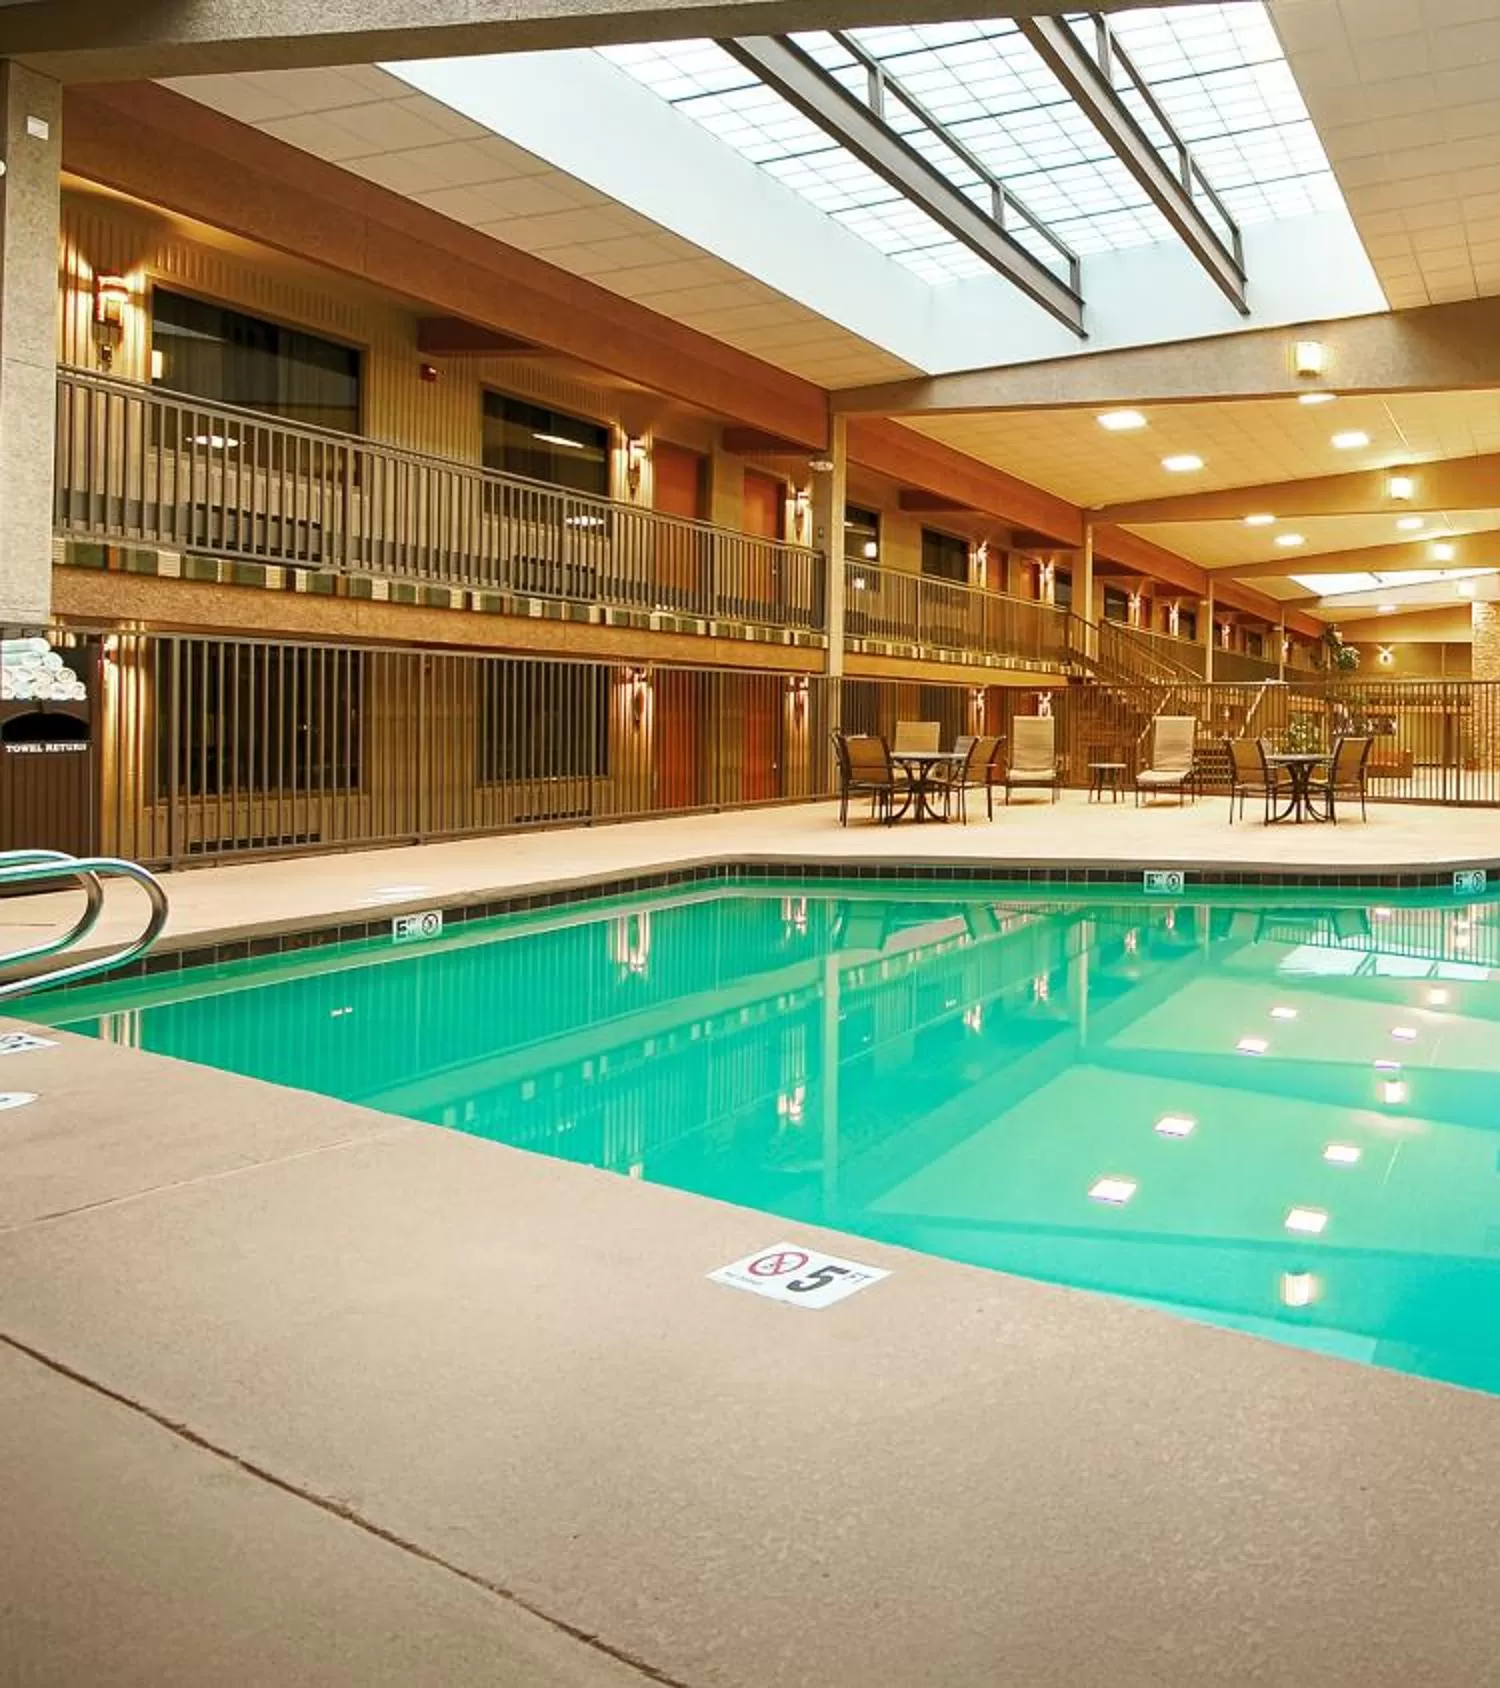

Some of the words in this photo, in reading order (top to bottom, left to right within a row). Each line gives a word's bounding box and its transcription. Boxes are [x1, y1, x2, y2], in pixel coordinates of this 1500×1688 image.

[6, 743, 43, 753] TOWEL
[45, 743, 87, 752] RETURN
[786, 1265, 851, 1293] 5
